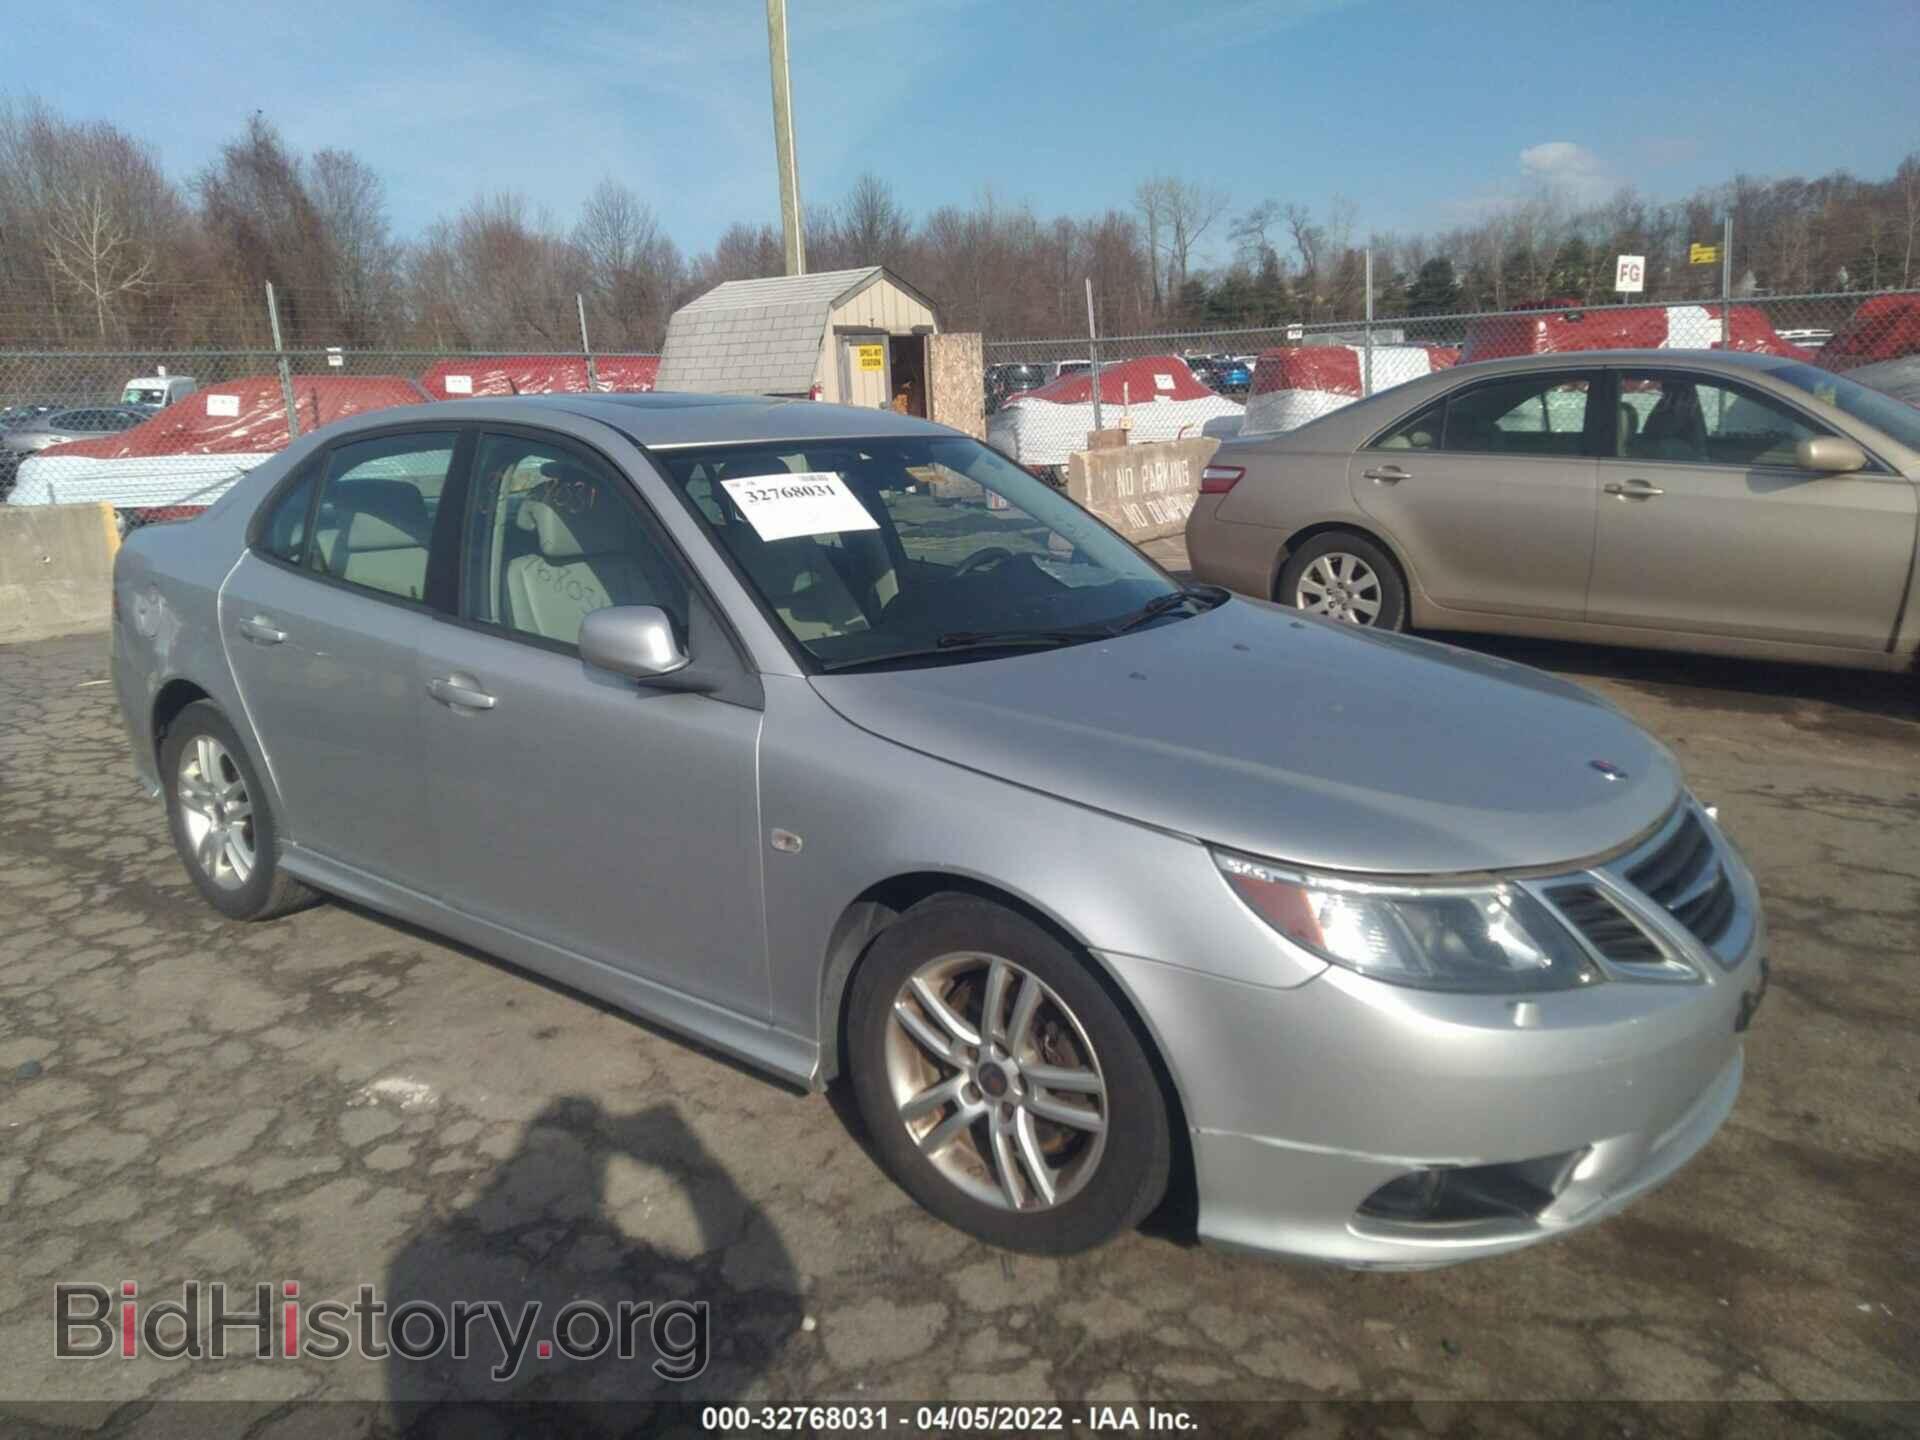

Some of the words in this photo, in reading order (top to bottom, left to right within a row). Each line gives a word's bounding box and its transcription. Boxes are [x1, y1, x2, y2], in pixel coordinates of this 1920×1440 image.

[1619, 263, 1641, 283] FG
[1116, 467, 1134, 498] NO
[1142, 460, 1190, 493] PARKING
[744, 484, 836, 503] 32768031
[1122, 502, 1148, 529] NO
